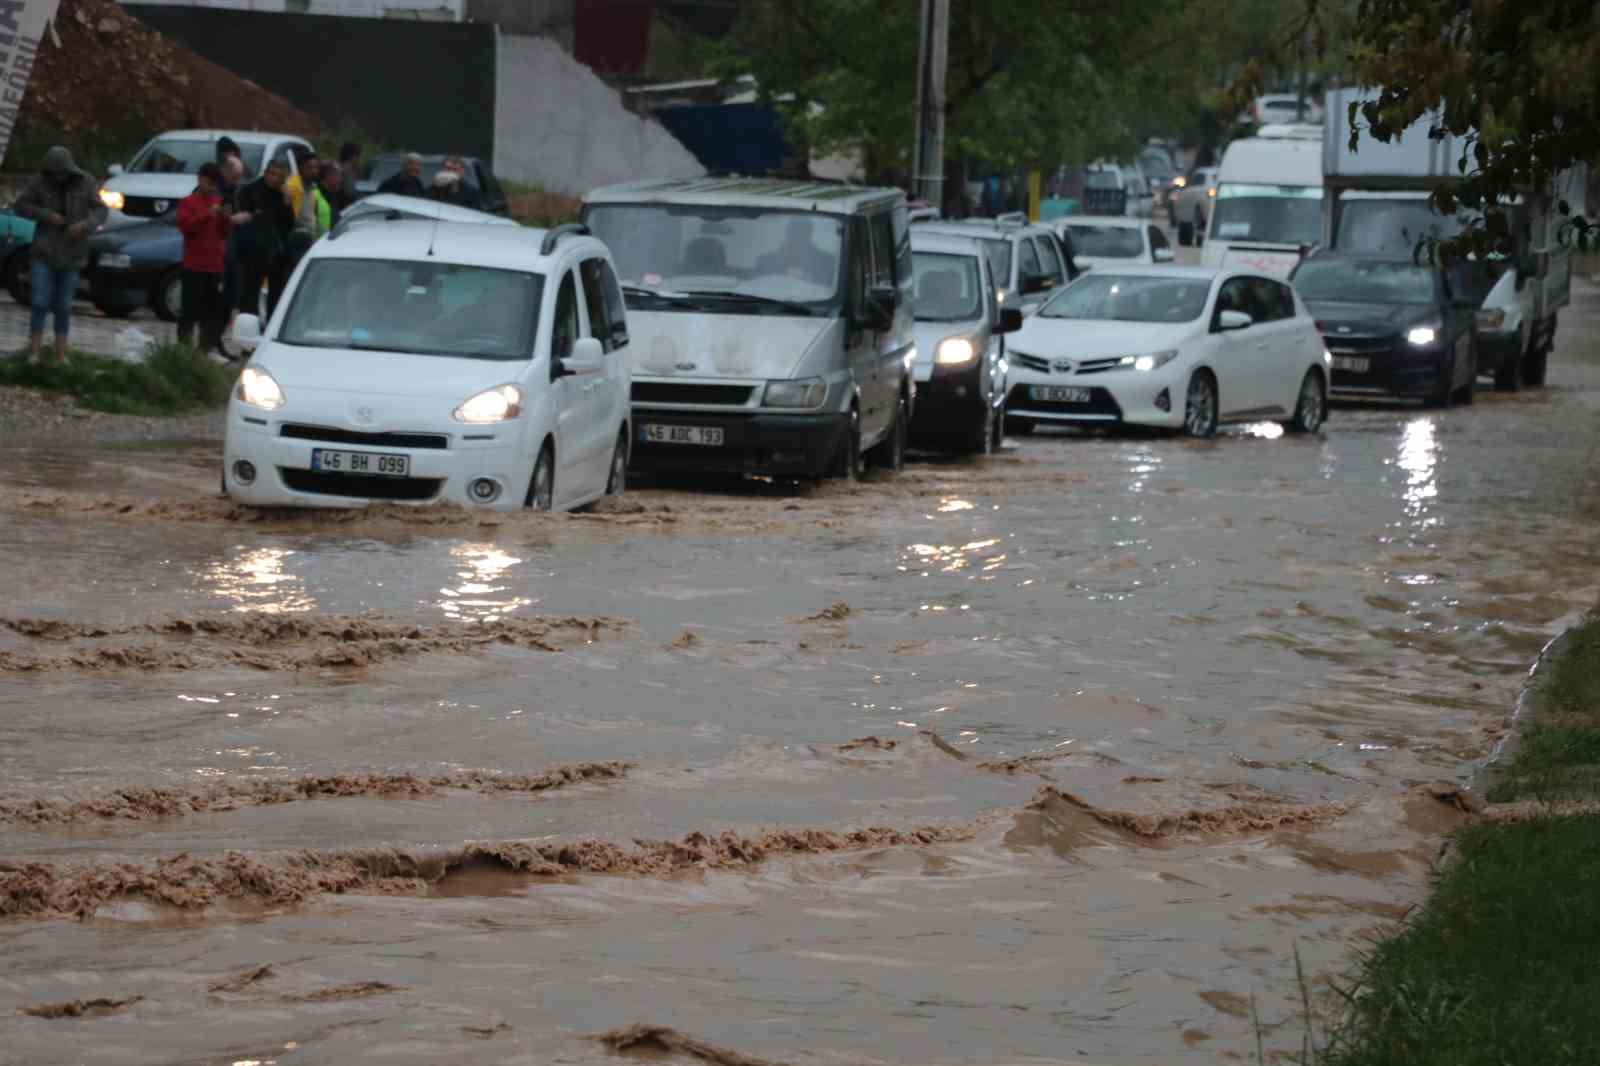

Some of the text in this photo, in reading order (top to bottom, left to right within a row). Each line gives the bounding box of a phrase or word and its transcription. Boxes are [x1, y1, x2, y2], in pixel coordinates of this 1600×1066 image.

[700, 428, 721, 444] 193
[323, 453, 405, 474] 46 BH 099
